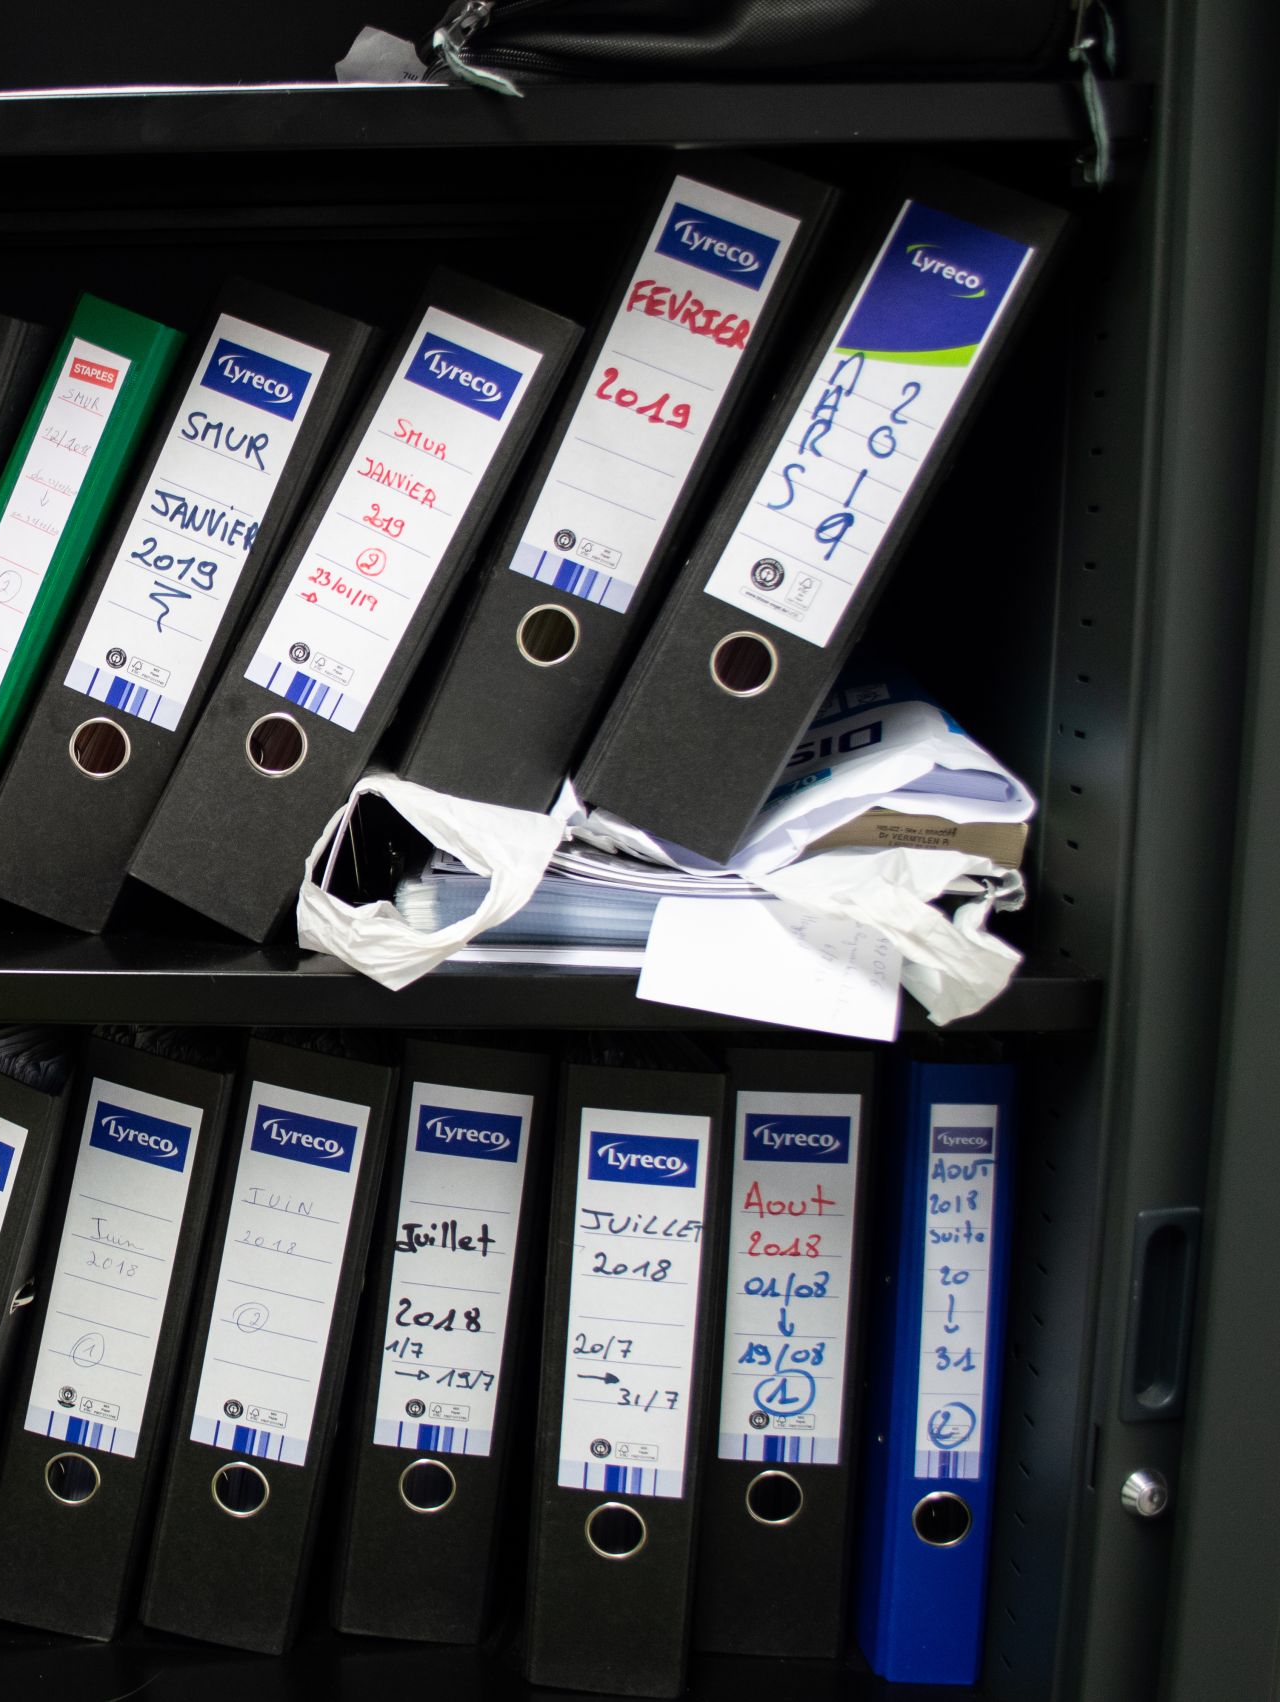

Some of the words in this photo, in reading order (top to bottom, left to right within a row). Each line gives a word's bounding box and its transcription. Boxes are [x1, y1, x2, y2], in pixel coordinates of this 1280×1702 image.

[681, 223, 755, 269] Lyreco
[912, 248, 981, 292] Lyreco
[625, 280, 750, 350] FEVRIER
[73, 363, 115, 384] STAPLES
[223, 359, 289, 398] Lyreco
[430, 353, 499, 402] Lyreco
[595, 368, 692, 430] 2019
[181, 411, 269, 471] SMUR
[131, 537, 219, 591] 2019
[308, 567, 379, 612] 23/01/19
[109, 1121, 174, 1154] Lyreco
[270, 1122, 339, 1154] Lyreco
[435, 1121, 505, 1146] Lyreco
[761, 1125, 835, 1150] Lyreco
[942, 1133, 987, 1148] Lyreco
[607, 1147, 684, 1172] Lyreco
[929, 1190, 979, 1215] 2018
[242, 1230, 297, 1255] 2018
[394, 1221, 496, 1258] Juillet
[746, 1230, 823, 1258] 2018
[86, 1252, 139, 1278] 2018
[592, 1252, 672, 1282] 2018
[938, 1266, 970, 1286] 20
[744, 1271, 831, 1307] 01/08
[395, 1297, 481, 1333] 2018
[386, 1337, 424, 1360] 1/7
[573, 1333, 633, 1360] 20/7
[737, 1342, 826, 1369] 19/08
[935, 1346, 976, 1372] 31
[436, 1369, 496, 1393] 19/7
[618, 1388, 679, 1411] 31/7
